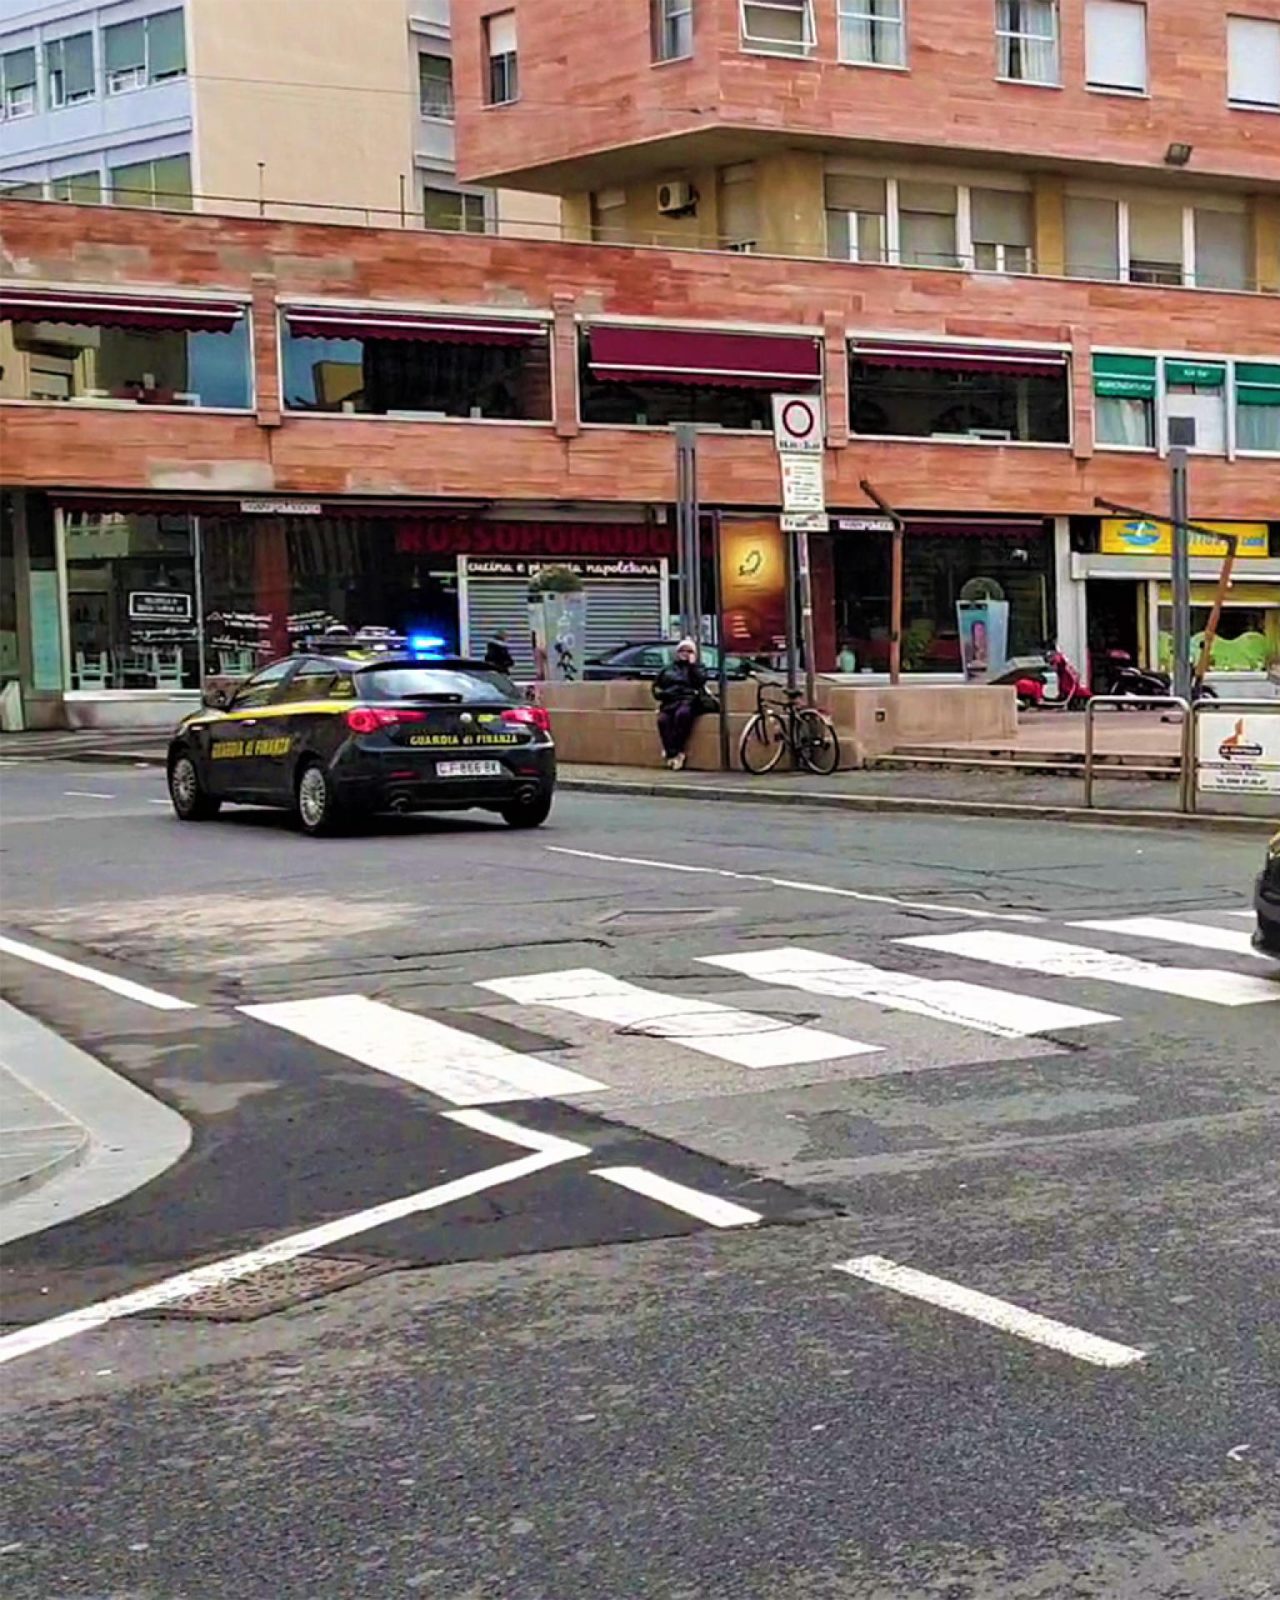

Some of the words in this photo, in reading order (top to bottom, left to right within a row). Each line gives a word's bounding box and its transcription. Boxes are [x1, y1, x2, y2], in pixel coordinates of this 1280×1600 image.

[468, 561, 513, 573] cucina
[517, 563, 525, 573] e
[587, 560, 658, 576] napoletana
[410, 735, 459, 746] GUARDIA
[476, 734, 518, 745] FINANZA
